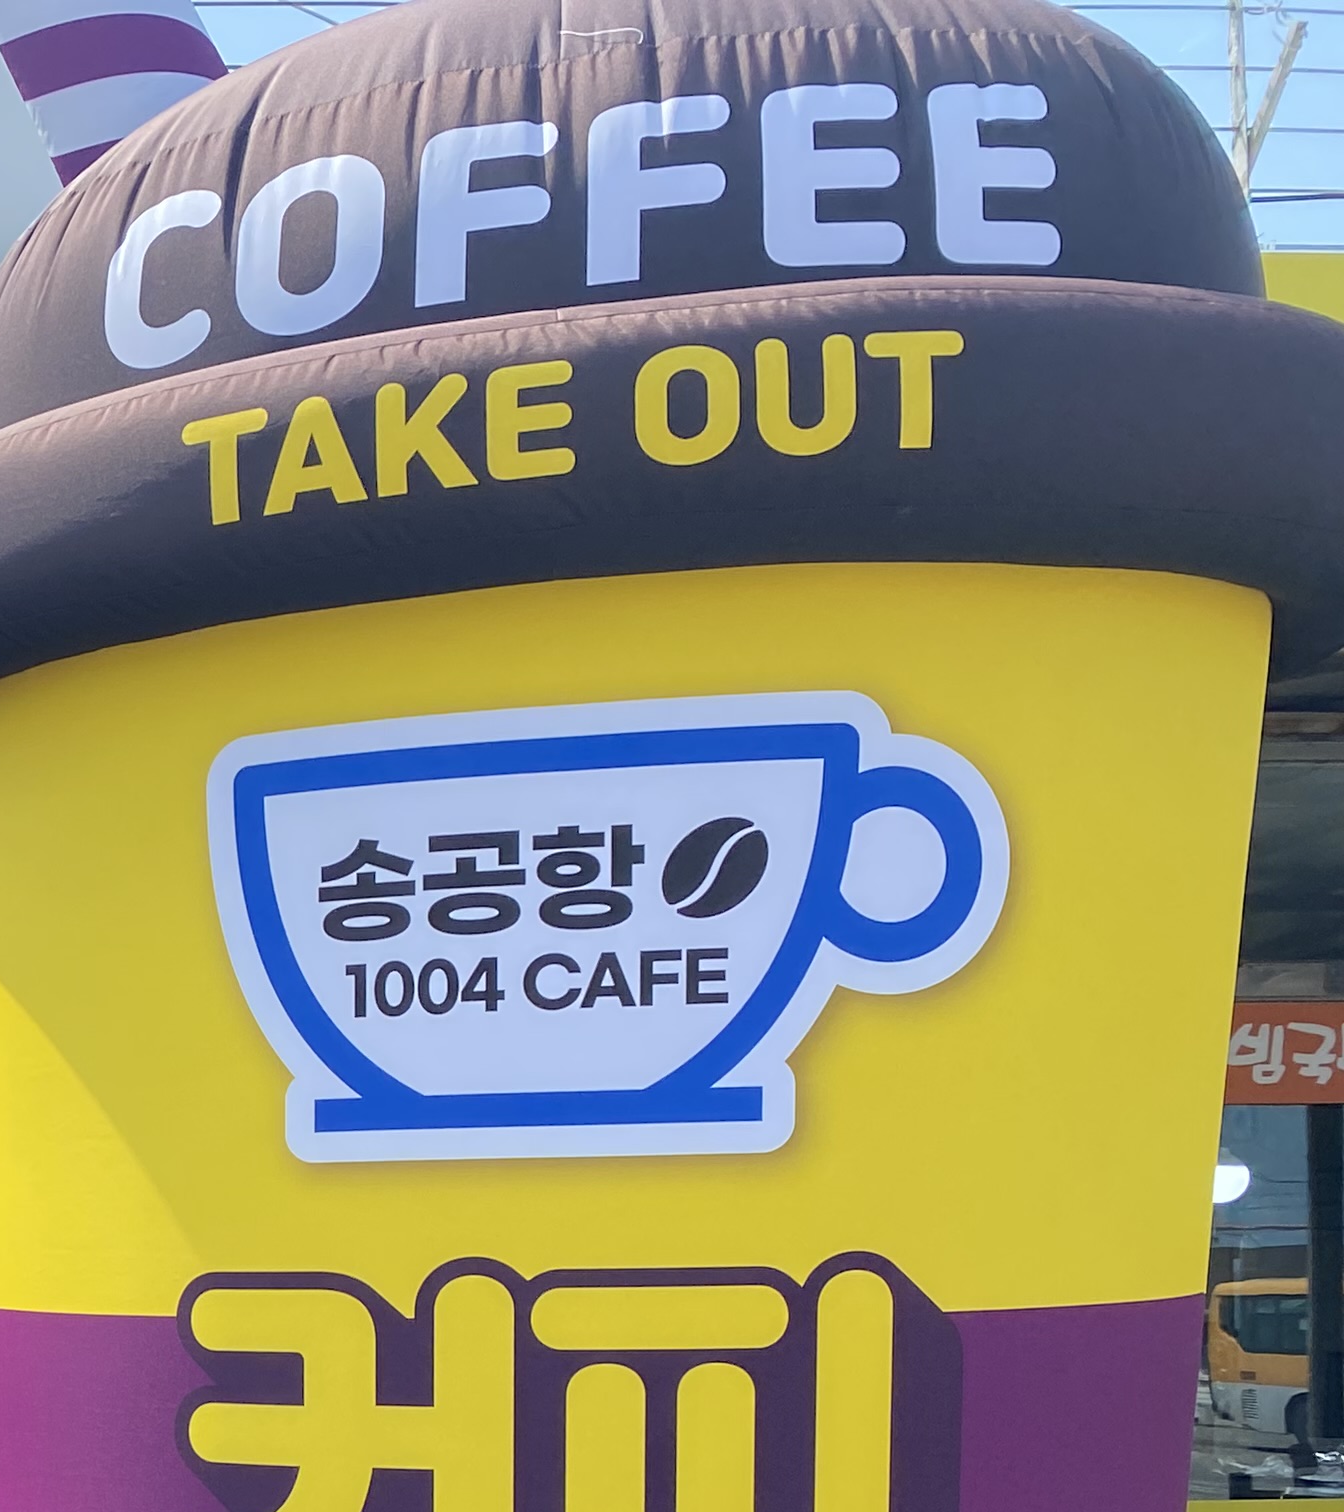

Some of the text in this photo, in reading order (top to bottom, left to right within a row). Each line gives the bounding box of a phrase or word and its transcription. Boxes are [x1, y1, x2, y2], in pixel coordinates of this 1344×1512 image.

[103, 83, 1063, 370] COFFEE
[181, 329, 965, 527] TAKE OUT
[317, 823, 646, 942] 송공항
[344, 947, 730, 1020] 1004 CAFE
